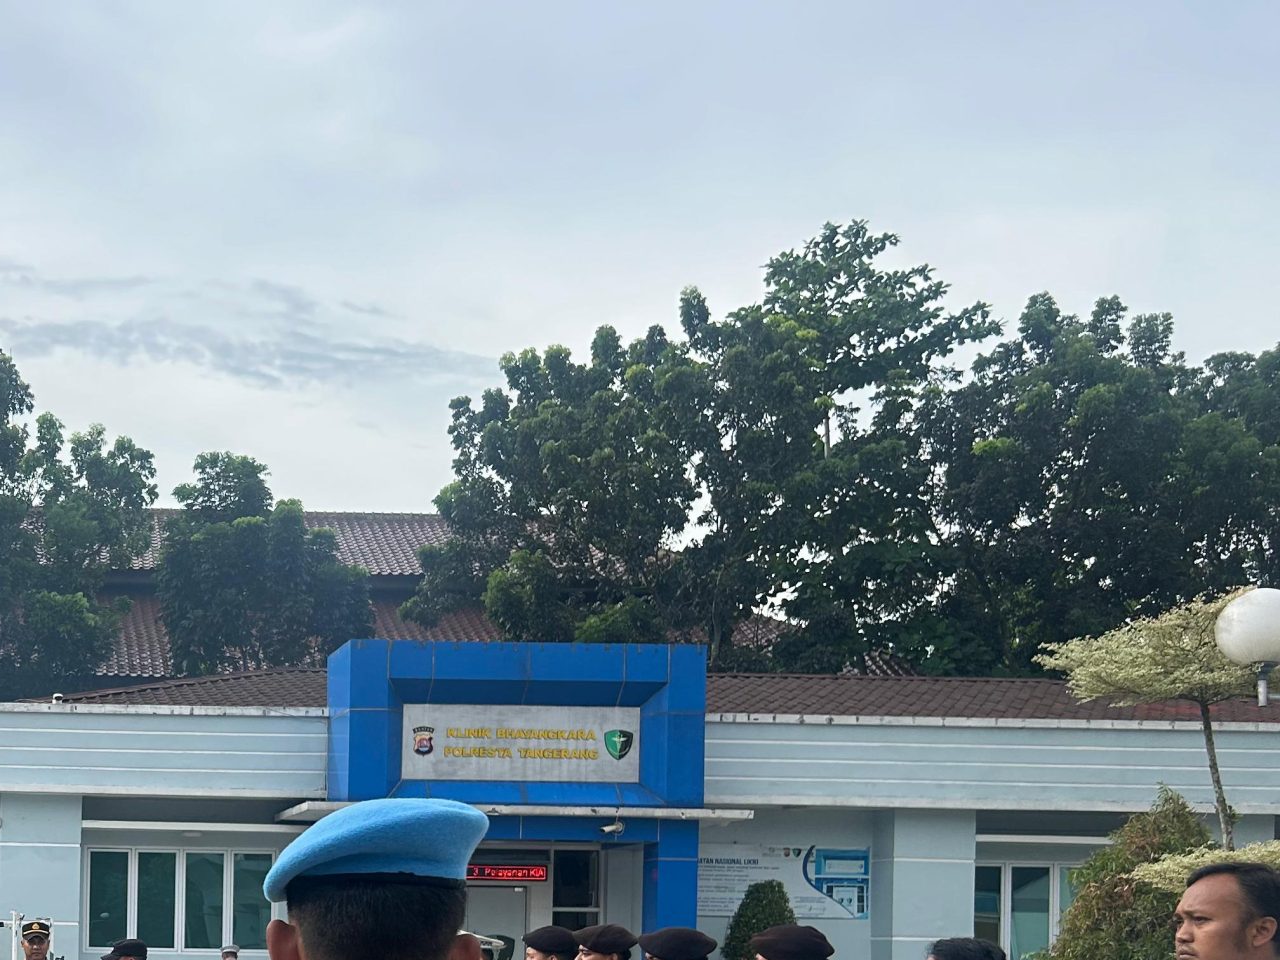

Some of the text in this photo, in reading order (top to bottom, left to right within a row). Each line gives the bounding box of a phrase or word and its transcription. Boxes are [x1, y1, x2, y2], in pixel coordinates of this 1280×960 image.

[446, 727, 596, 741] KLINIK BHAYANGKARA
[444, 746, 598, 760] POLRESTA TANGERANG
[484, 868, 528, 877] Pelayanan
[529, 867, 544, 877] KIA
